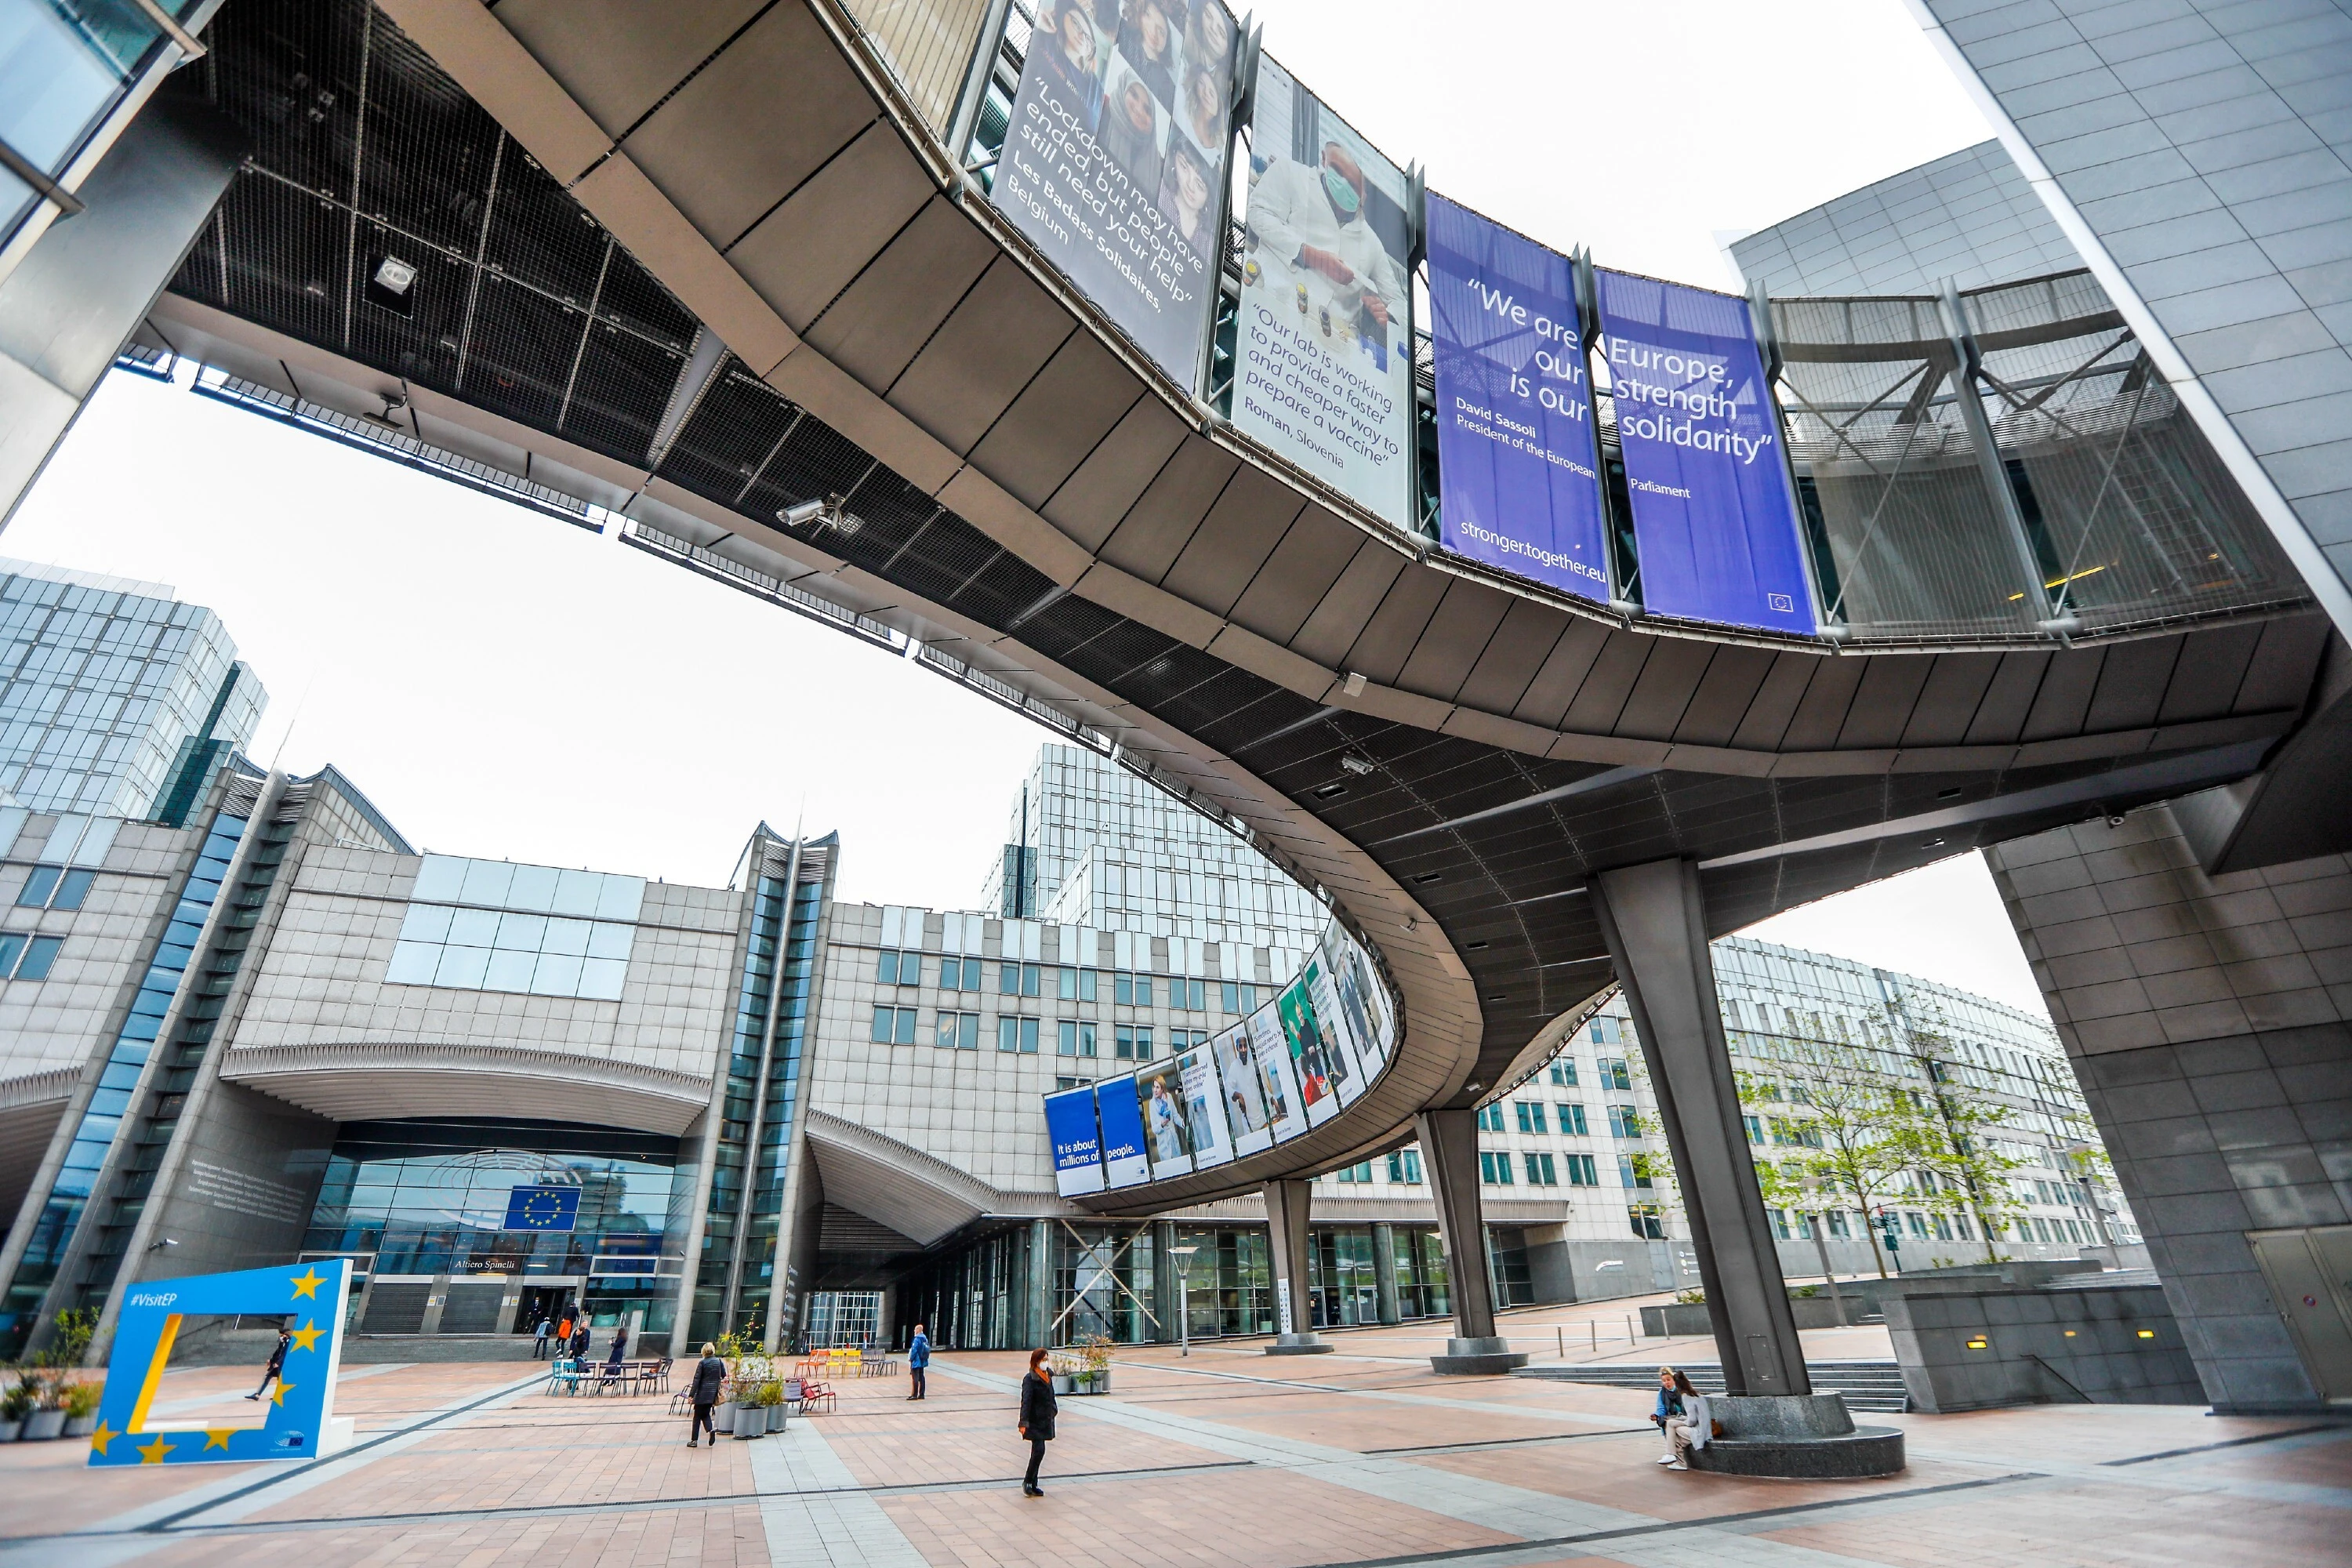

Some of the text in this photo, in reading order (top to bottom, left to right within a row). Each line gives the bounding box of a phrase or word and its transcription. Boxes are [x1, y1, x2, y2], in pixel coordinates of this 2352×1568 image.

[1026, 103, 1184, 277] ended, but people
[1035, 77, 1203, 274] “Lockdown may have
[1008, 175, 1069, 245] Belgium
[1014, 150, 1162, 313] Les Badass Solidaires,
[1020, 125, 1192, 303] still need your help”
[1468, 278, 1579, 350] “We are
[1250, 325, 1386, 425] to provide a faster
[1253, 303, 1392, 414] “Our lab is working
[1535, 350, 1584, 385] our
[1610, 338, 1734, 390] Europe,
[1246, 370, 1389, 466] prepare a vaccine”
[1248, 349, 1399, 456] and cheaper way to
[1456, 396, 1537, 439] David Sassoli
[1510, 367, 1588, 422] is our
[1616, 378, 1737, 421] strength
[1244, 396, 1345, 470] Roman, Slovenia
[1457, 414, 1596, 481] President of the European
[1622, 413, 1773, 465] solidarity”
[1630, 478, 1691, 499] Parliament
[1461, 519, 1607, 584] stronger.together.eu
[1058, 1138, 1097, 1155] It is about
[1059, 1149, 1100, 1167] millions of
[1107, 1143, 1135, 1160] people.
[456, 1260, 515, 1270] Altiero Spinelli
[129, 1293, 178, 1307] #VisitEP
